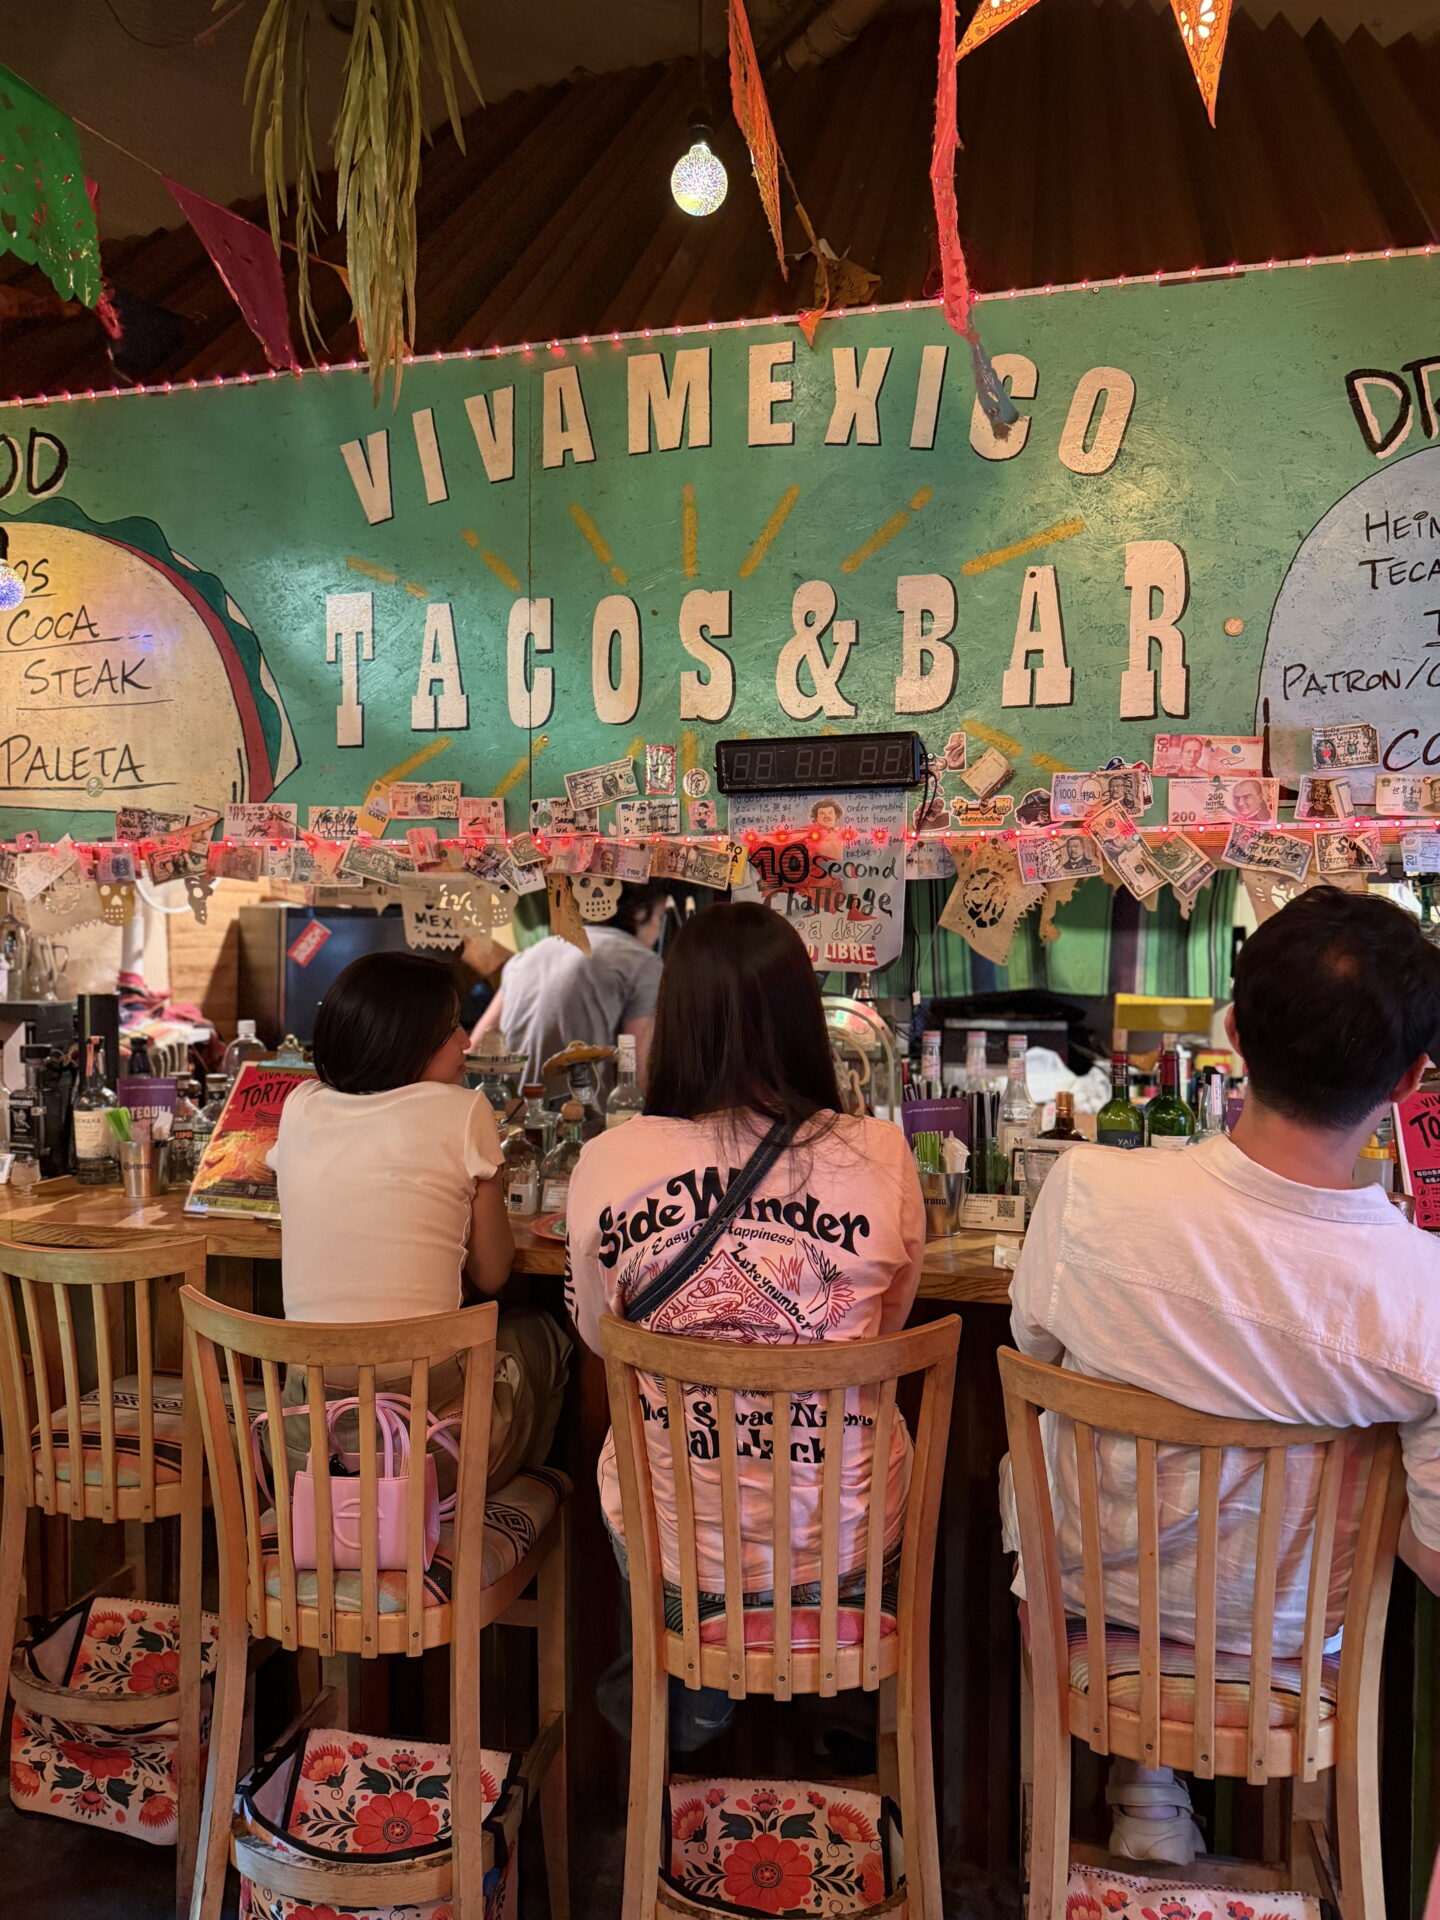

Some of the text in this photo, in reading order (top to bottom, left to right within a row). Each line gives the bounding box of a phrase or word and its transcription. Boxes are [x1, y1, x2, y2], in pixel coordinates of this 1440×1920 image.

[340, 341, 1136, 525] VIVA MEXICO
[7, 604, 101, 647] COCA
[326, 539, 1190, 748] TACOS & BAR
[24, 657, 153, 698] STEAK
[1158, 738, 1169, 753] 50
[0, 734, 146, 785] PALETA
[1060, 788, 1077, 799] 1000
[1207, 793, 1224, 801] 200
[368, 810, 387, 823] COCO
[857, 814, 869, 823] the
[873, 814, 897, 824] house
[1171, 811, 1197, 823] 200
[750, 844, 810, 888] 10
[808, 920, 823, 940] a
[824, 941, 878, 965] LIBRE
[677, 1311, 698, 1327] 1987
